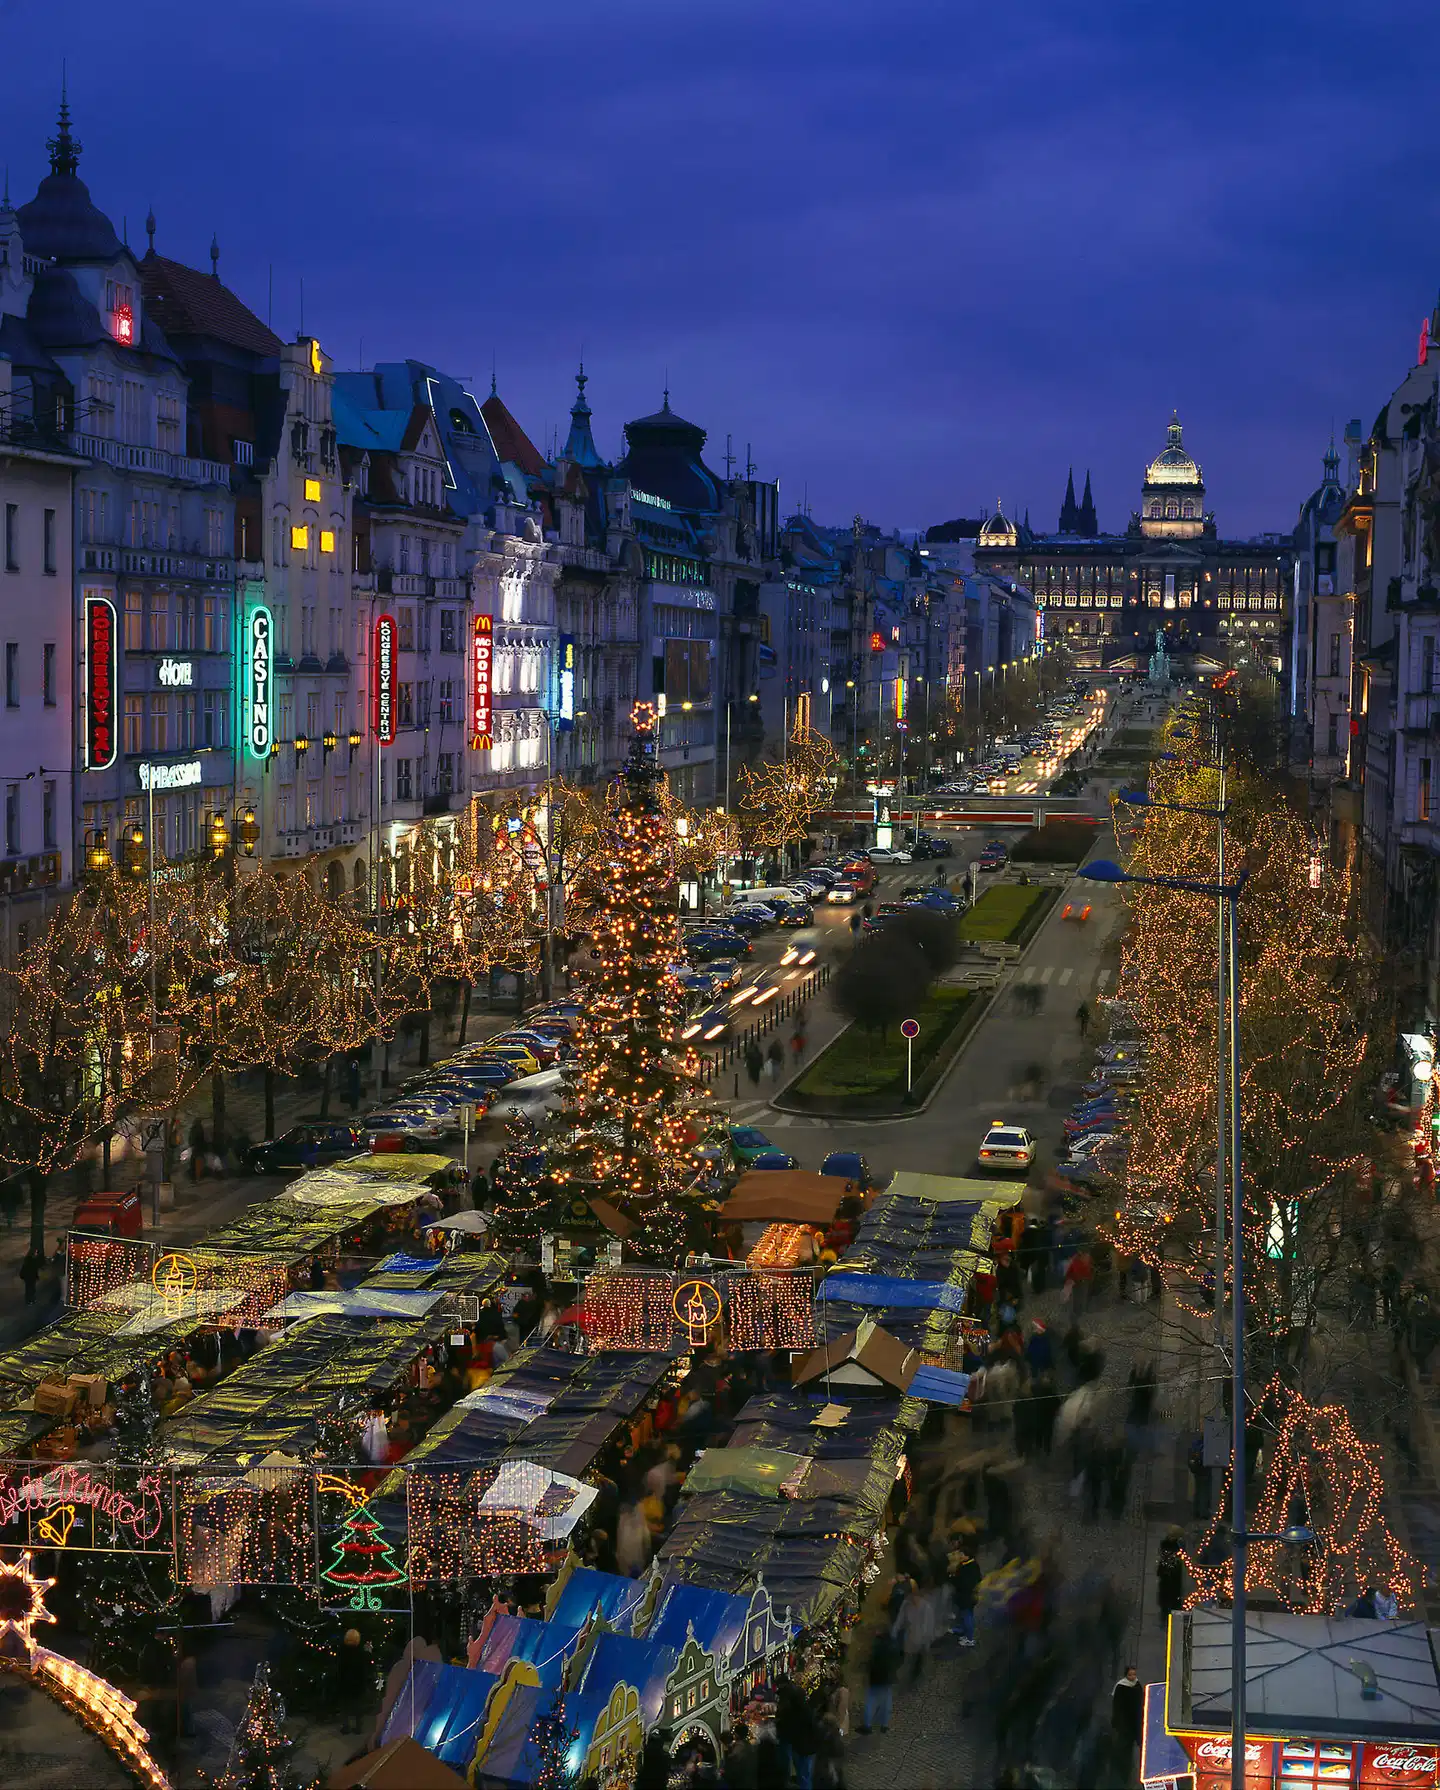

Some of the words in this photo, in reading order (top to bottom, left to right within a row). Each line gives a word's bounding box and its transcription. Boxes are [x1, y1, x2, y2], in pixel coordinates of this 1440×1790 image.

[253, 617, 268, 746] CASINO
[380, 692, 391, 741] CENTRUM
[475, 637, 491, 731] McDonald's
